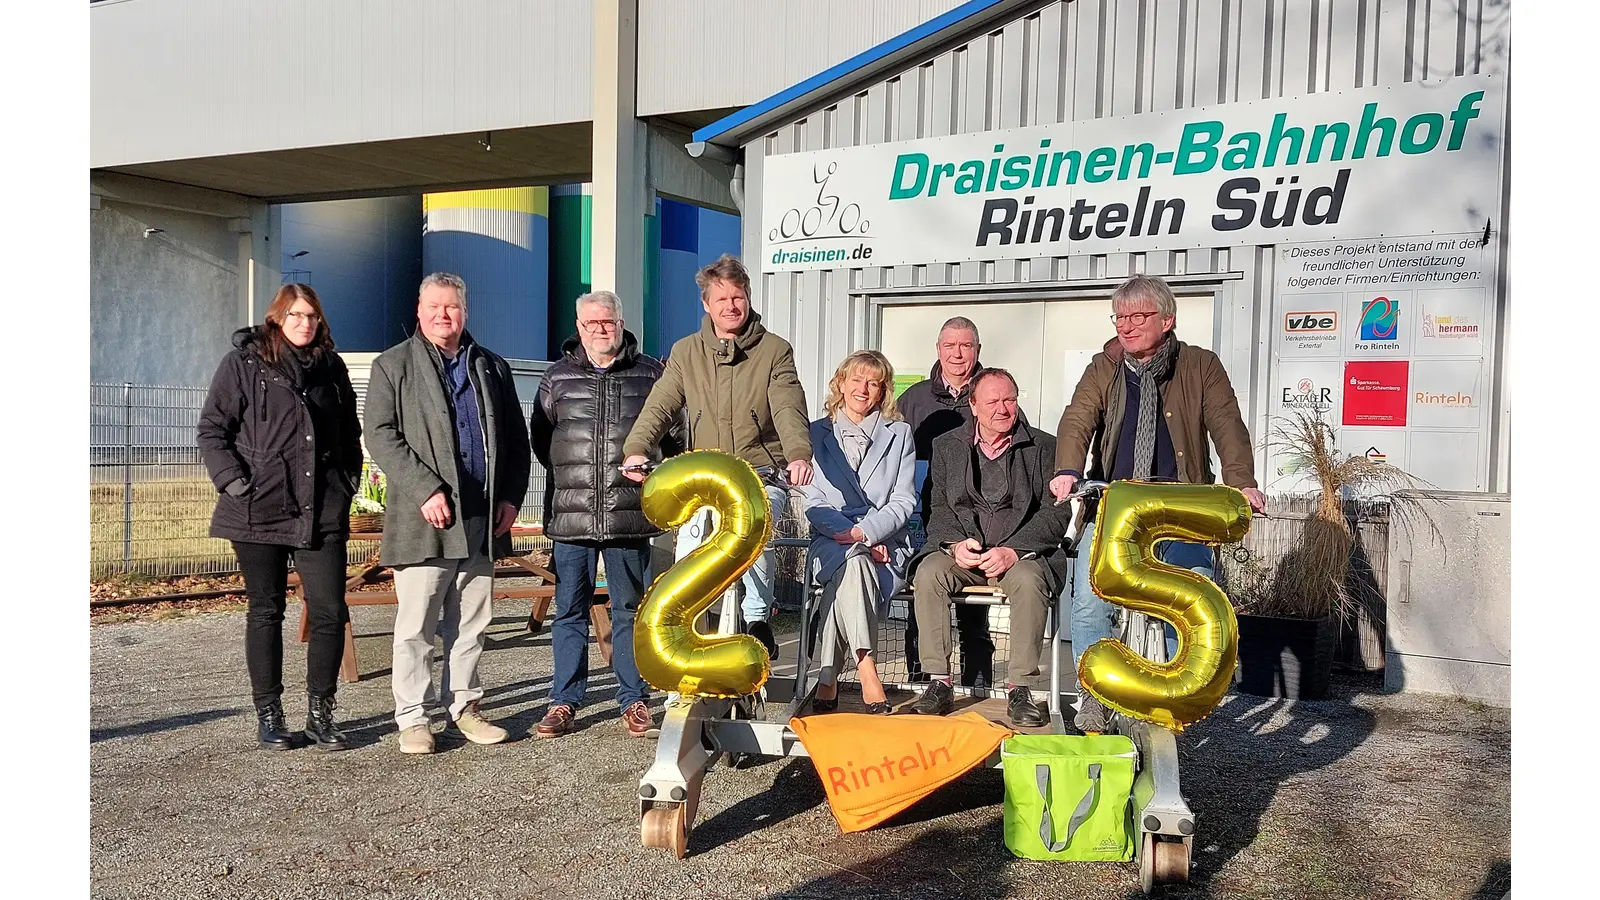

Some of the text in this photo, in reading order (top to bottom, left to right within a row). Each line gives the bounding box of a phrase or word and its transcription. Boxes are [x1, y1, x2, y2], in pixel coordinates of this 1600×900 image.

[889, 90, 1485, 201] Draisinen-Bahnhof
[976, 168, 1351, 247] Rinteln Süd
[772, 243, 873, 265] draisinen.de
[1290, 239, 1480, 258] Dieses Projekt entstand mit der
[1302, 255, 1466, 272] freundlichen Unterstützung
[1287, 270, 1481, 288] folgender Firmen/Einrichtungen:
[1287, 314, 1334, 330] vbe
[1435, 315, 1452, 323] land
[1439, 324, 1479, 333] hermann
[1371, 342, 1400, 350] Rinteln
[1415, 391, 1472, 404] Rinteln
[670, 701, 692, 709] 27
[827, 741, 953, 797] Rinteln
